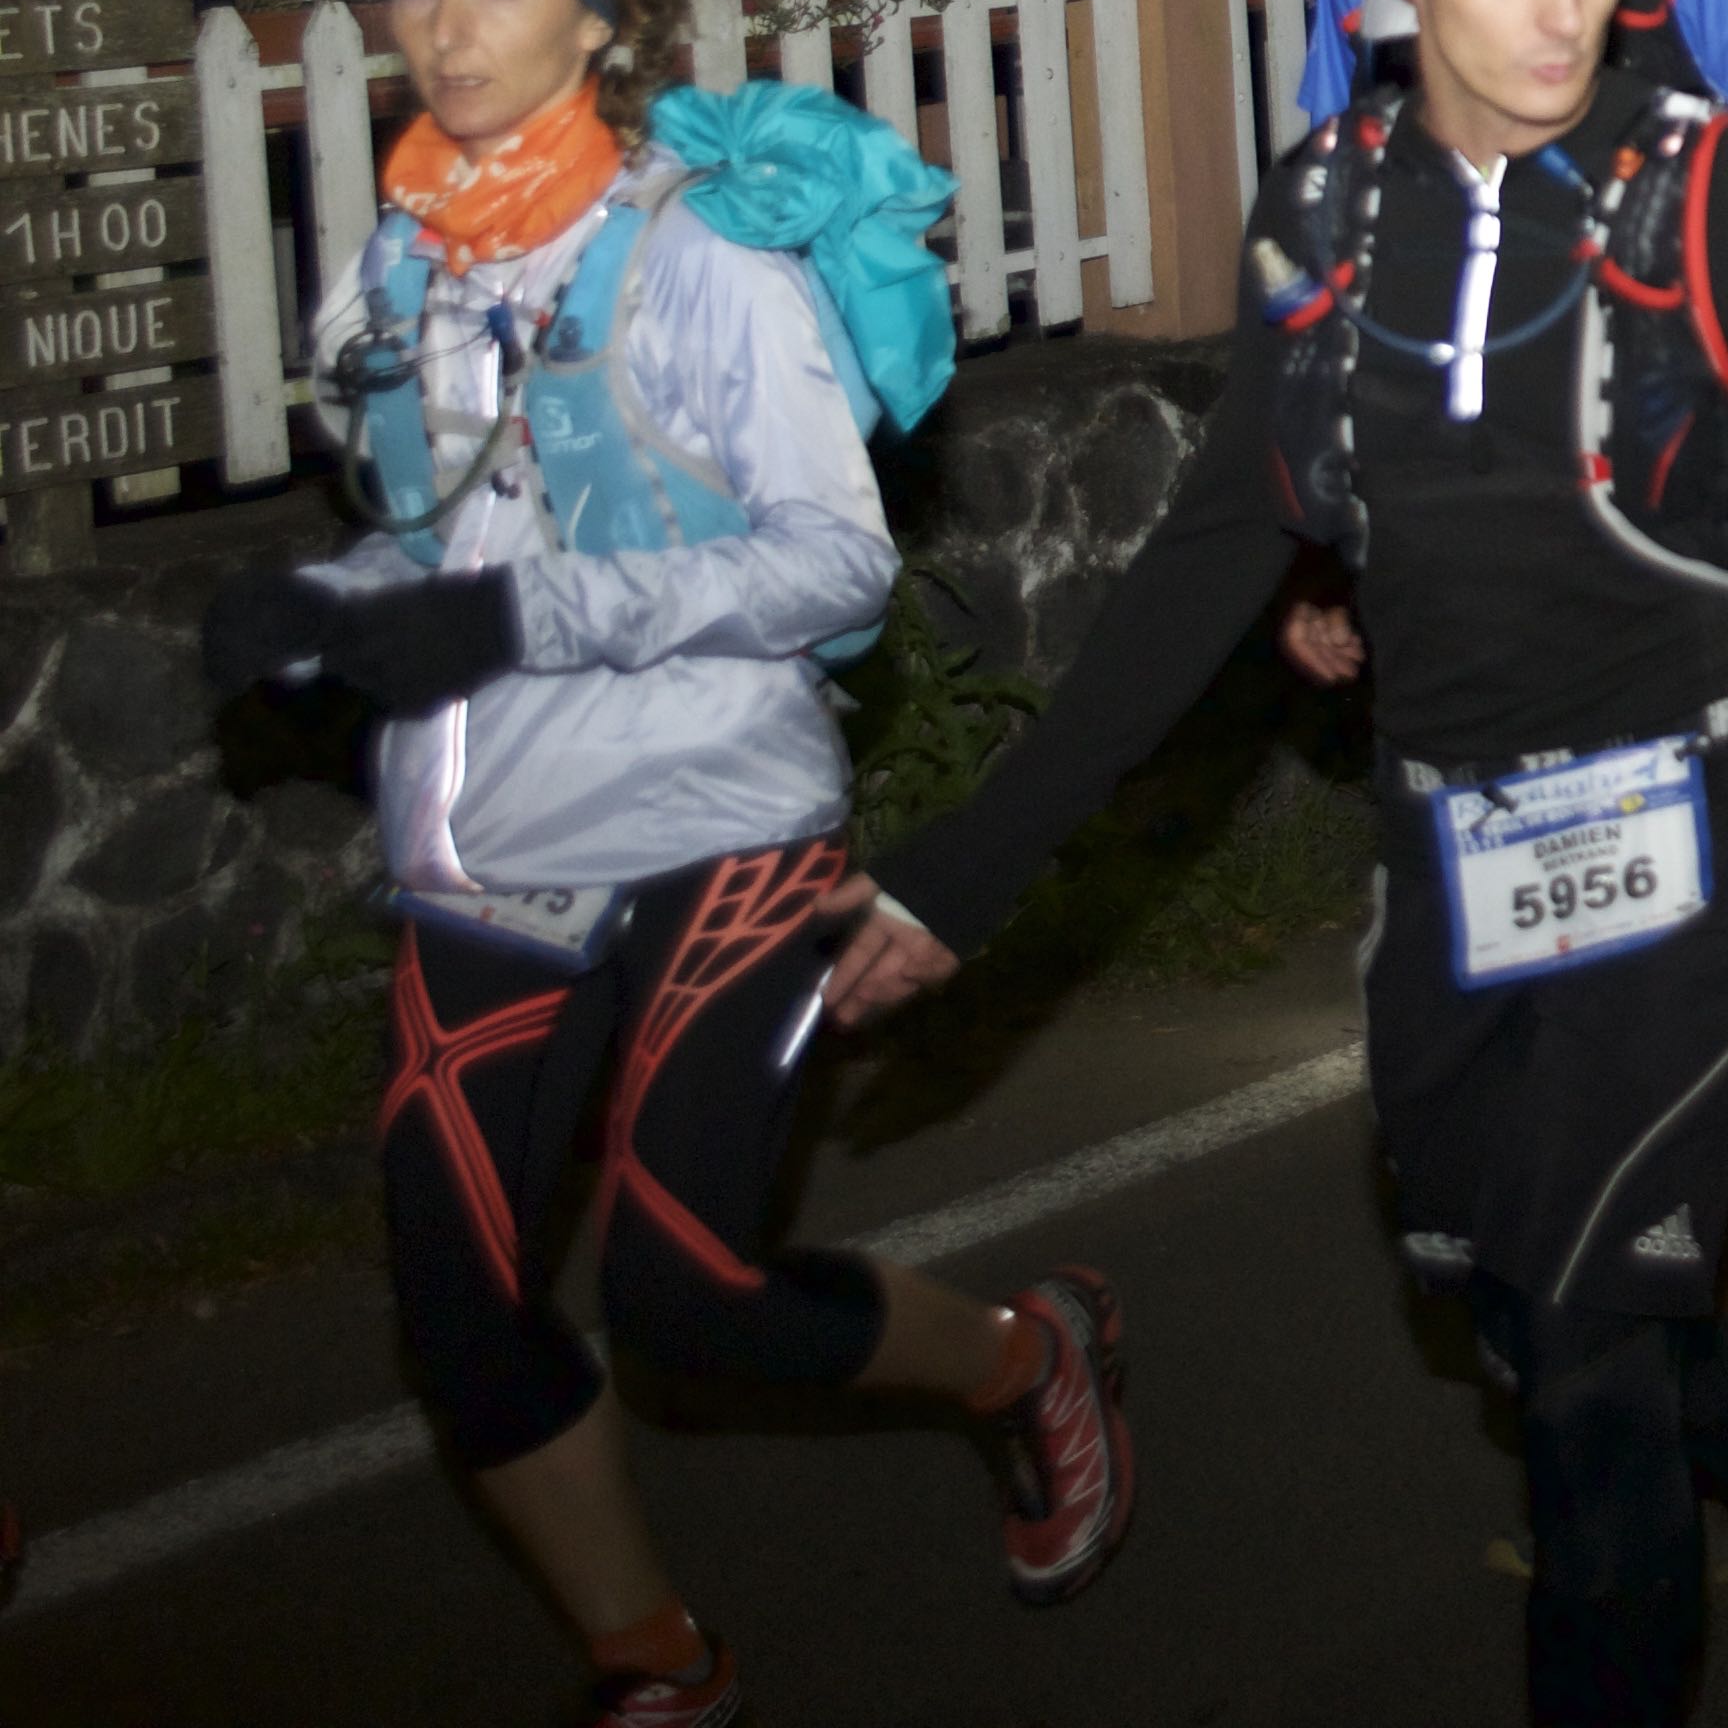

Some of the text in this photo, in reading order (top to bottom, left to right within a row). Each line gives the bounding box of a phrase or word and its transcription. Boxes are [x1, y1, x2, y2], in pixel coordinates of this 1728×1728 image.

[26, 297, 176, 369] NIQUE
[1533, 823, 1623, 859] DAMIEN
[1512, 855, 1658, 930] 5956
